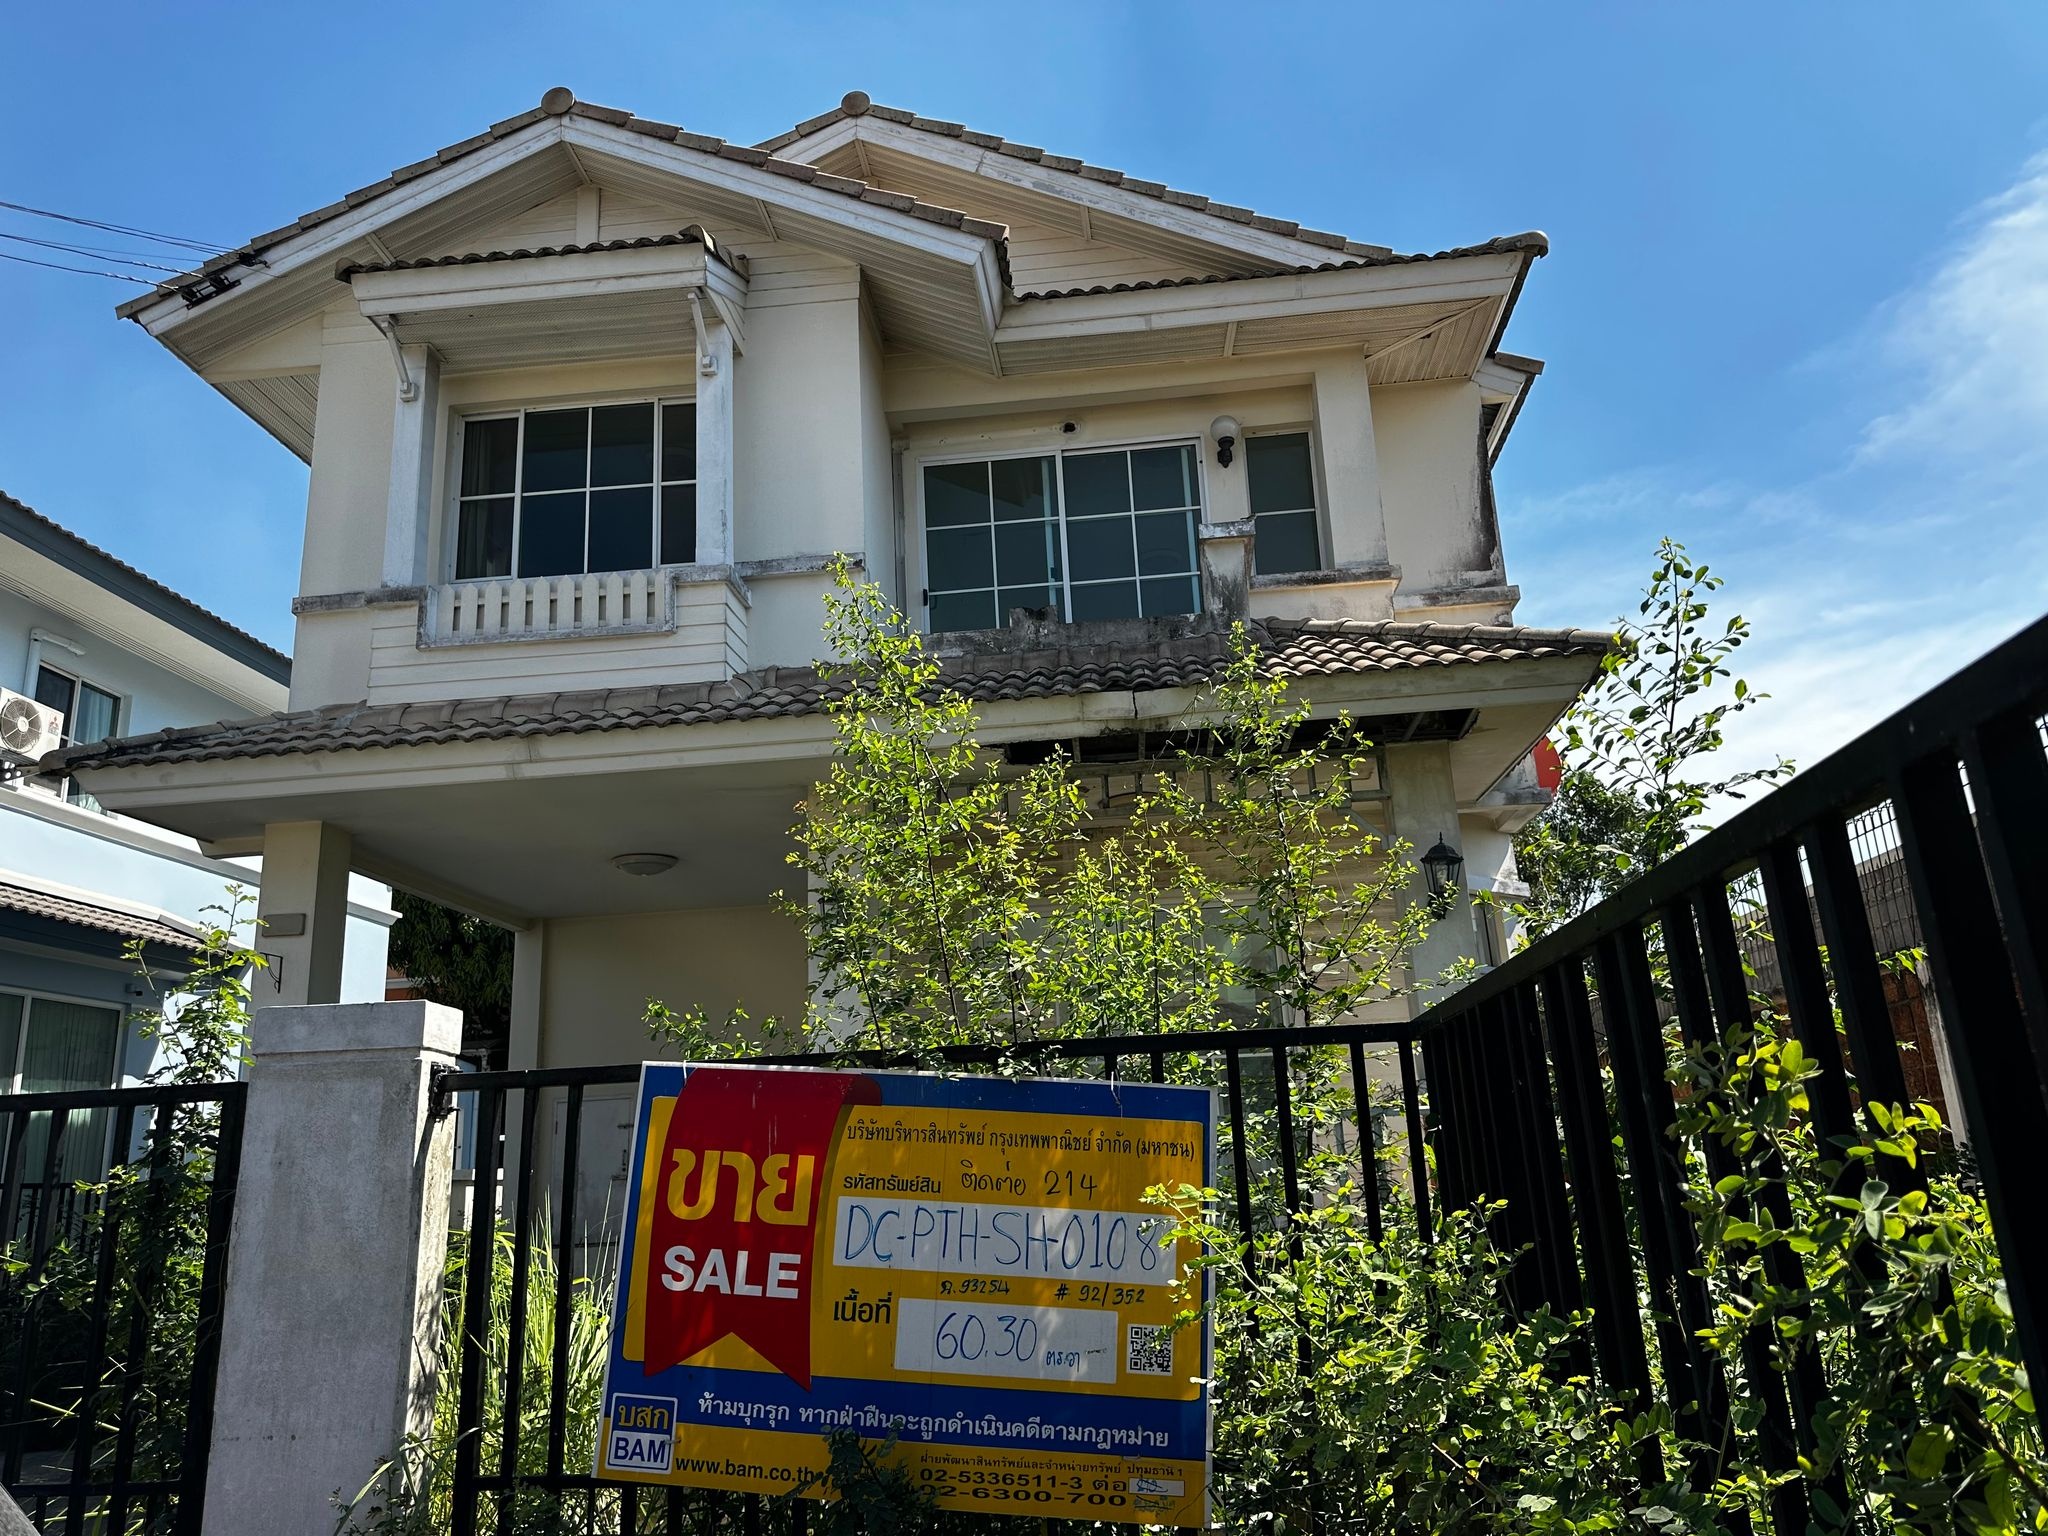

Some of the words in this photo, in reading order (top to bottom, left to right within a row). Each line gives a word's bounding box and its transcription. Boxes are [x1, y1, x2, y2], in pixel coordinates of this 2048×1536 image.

[848, 1119, 986, 1145] บริษัทบริหารสินทรัพย์
[989, 1127, 1094, 1155] กรุงเทพพาณิชย์
[1095, 1132, 1131, 1154] จำกัด
[1136, 1136, 1195, 1162] (มหาชน)
[667, 1148, 815, 1226] ขาย
[843, 1173, 941, 1194] รหัสทรัพย์สิน
[961, 1160, 1027, 1196] ติดต่อ
[1045, 1170, 1098, 1200] 214
[844, 1204, 1158, 1272] DC-PTH-SH-0108
[661, 1245, 801, 1299] SALE
[833, 1288, 892, 1324] เนื้อที่
[1077, 1284, 1146, 1307] 92/352
[935, 1312, 1038, 1362] 60.30
[618, 1404, 669, 1430] บสก
[698, 1391, 790, 1428] ห้ามบุกรุก
[613, 1436, 667, 1464] BAM
[675, 1455, 815, 1484] www.bam.co.th
[920, 1468, 1083, 1491] 02-5336511-3
[1093, 1474, 1127, 1492] ต่อ
